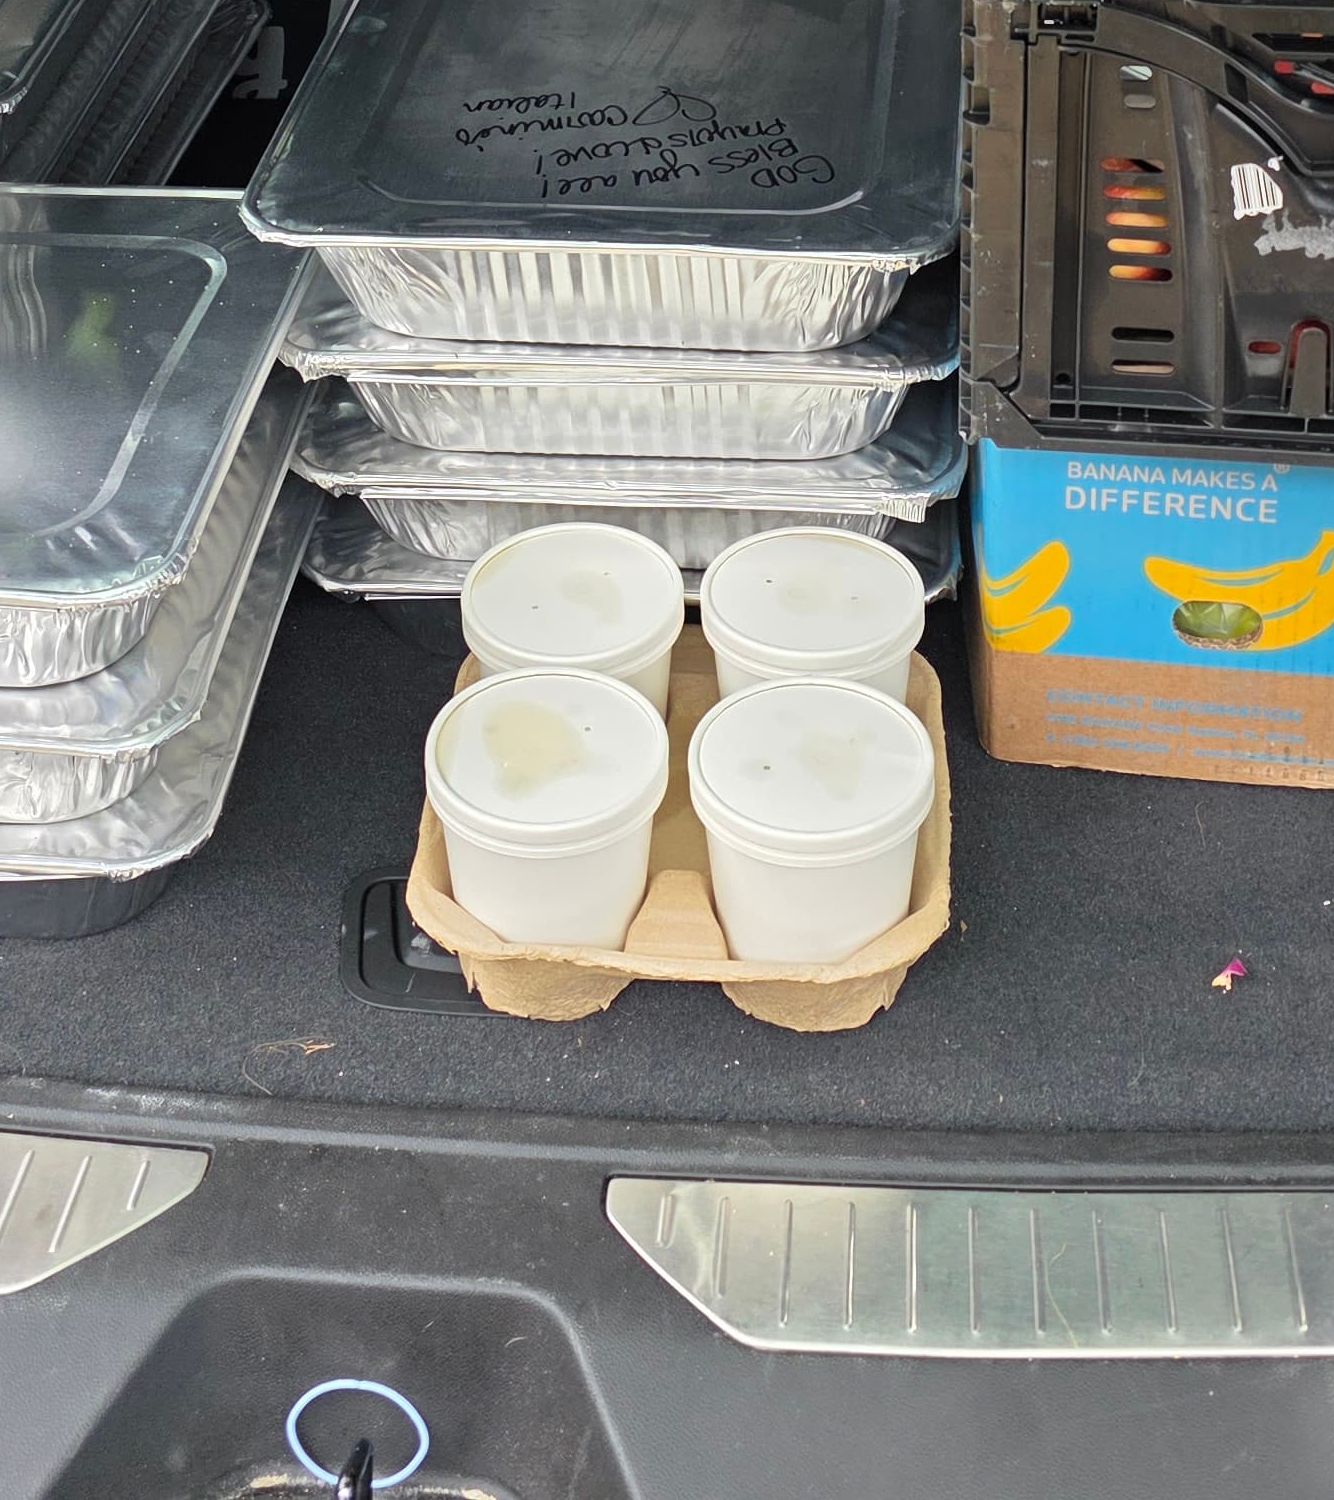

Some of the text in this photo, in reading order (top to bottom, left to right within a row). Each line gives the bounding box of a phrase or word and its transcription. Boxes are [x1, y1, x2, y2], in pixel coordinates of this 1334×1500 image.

[1067, 460, 1165, 485] BANANA
[1171, 467, 1256, 491] MAKES
[1064, 485, 1279, 525] DIFFERENCE
[1045, 688, 1303, 722] CONTACT INFORMATION
